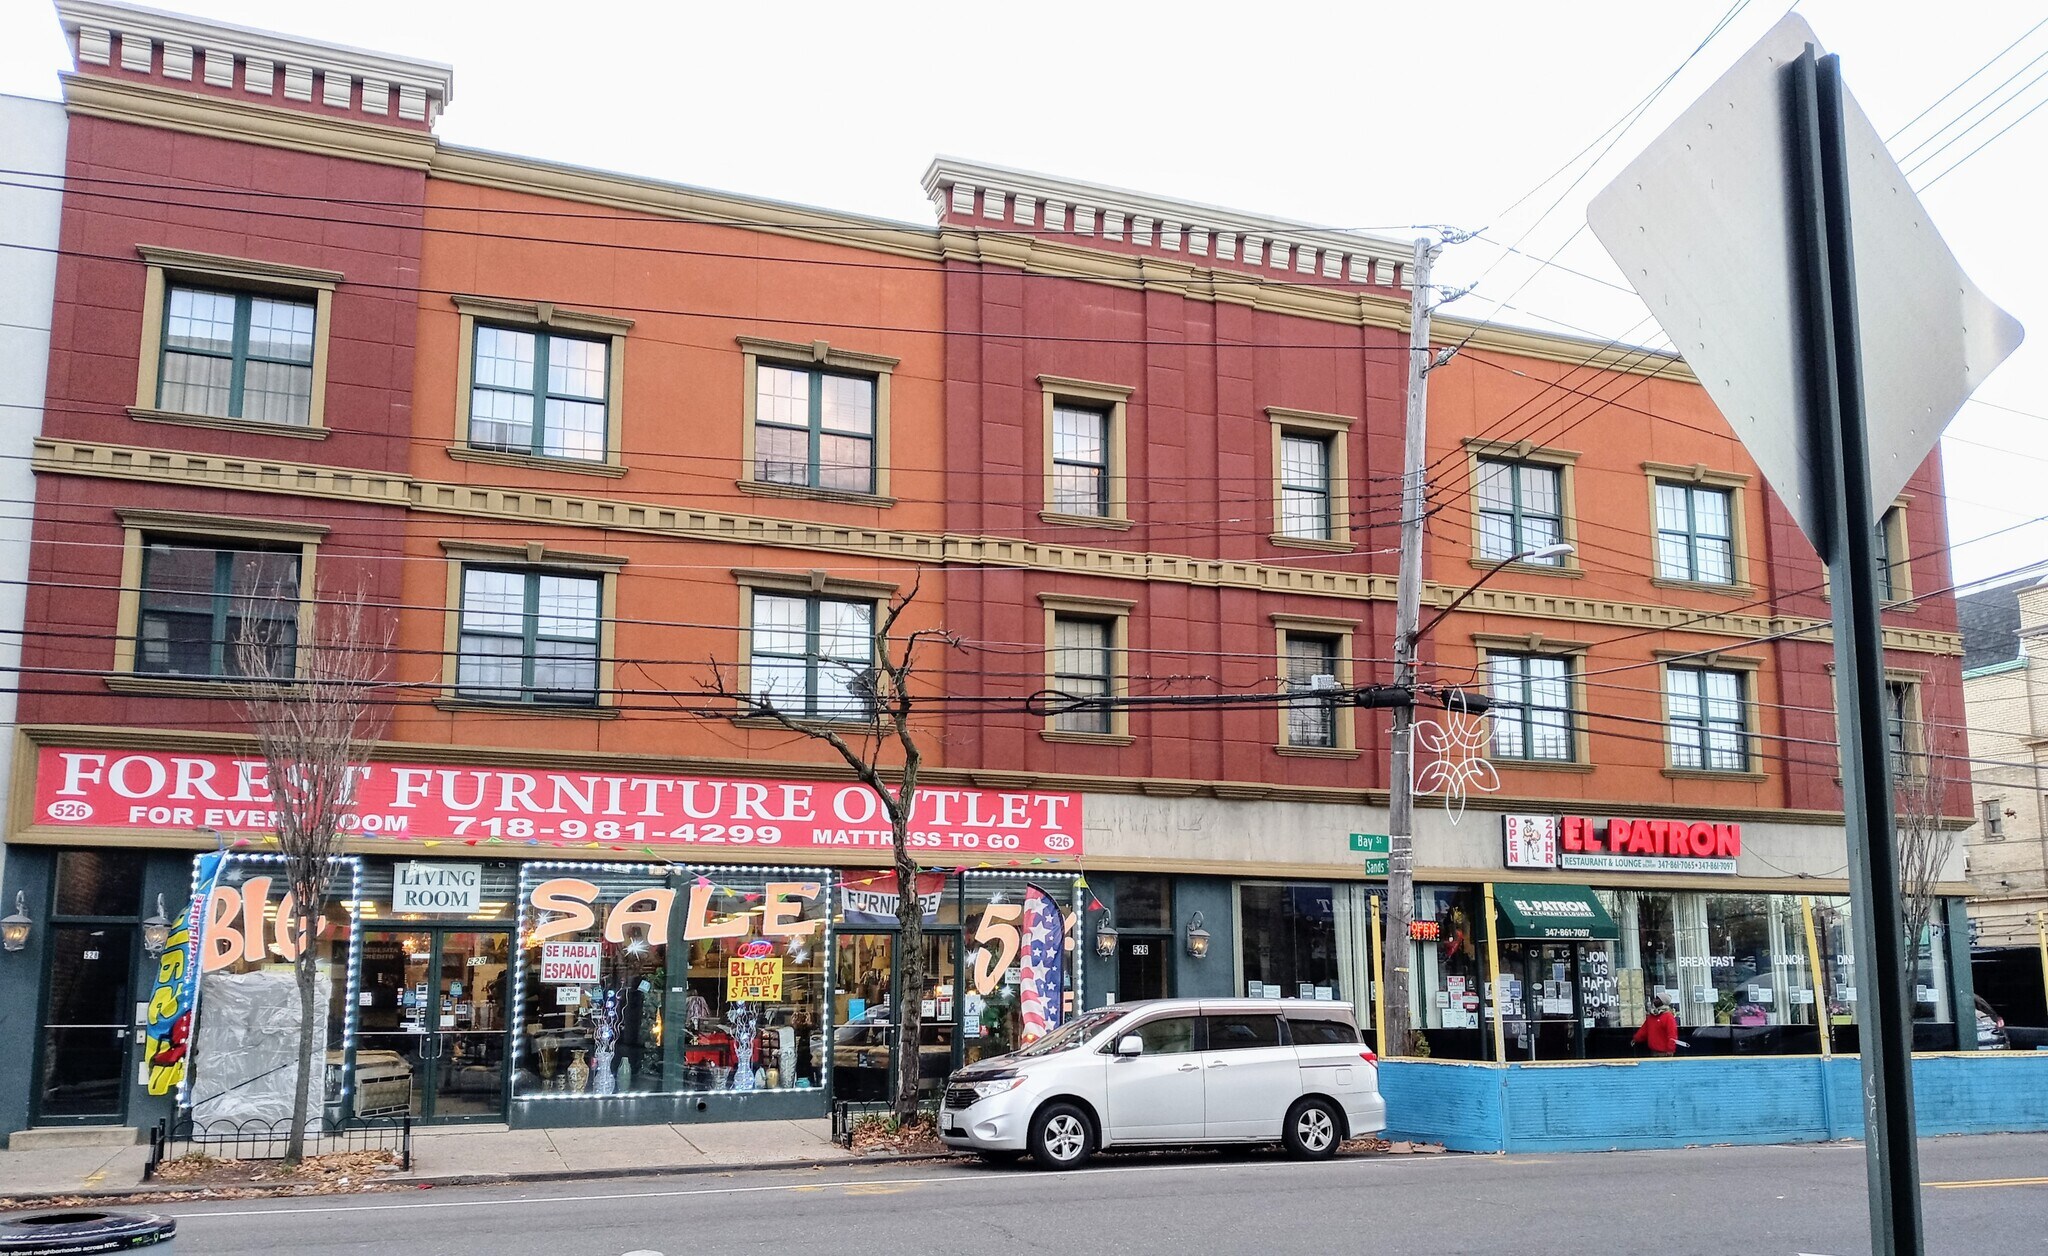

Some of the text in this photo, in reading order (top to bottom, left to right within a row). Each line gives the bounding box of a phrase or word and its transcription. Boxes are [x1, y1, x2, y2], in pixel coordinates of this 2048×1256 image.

[389, 767, 817, 822] FURNITURE
[833, 786, 1070, 830] OUTLET
[54, 804, 86, 817] 526
[128, 806, 194, 825] FOR
[447, 815, 783, 844] 718-981-4299
[812, 828, 1020, 849] MATTRESS TO GO
[1048, 836, 1070, 848] 526
[1357, 835, 1382, 850] Bay St
[1508, 817, 1519, 863] OPEN
[1562, 816, 1740, 857] EL PATRON
[1366, 860, 1385, 873] Sands
[1564, 856, 1642, 868] RESTAURANT & LOUNGE
[401, 869, 476, 887] LIVING
[404, 890, 469, 907] ROOM
[530, 878, 821, 945] SALE
[1514, 900, 1592, 911] EL PATRON
[1411, 922, 1437, 932] OPEN
[1544, 928, 1590, 937] 347-861-7097
[545, 945, 598, 958] SE HABLA
[737, 941, 776, 957] Open
[1133, 945, 1148, 955] 526
[1586, 952, 1609, 963] JOIN
[1679, 956, 1736, 967] BREAKFAST
[1774, 954, 1804, 965] LUNCH
[544, 960, 597, 979] ESPAÑOL
[730, 961, 776, 977] BLACK
[1592, 963, 1608, 975] US
[735, 976, 772, 987] FRIDAY
[1582, 977, 1619, 991] HAPPY
[1583, 993, 1620, 1007] HOUR!
[1468, 1015, 1476, 1025] A
[83, 1244, 104, 1252] across
